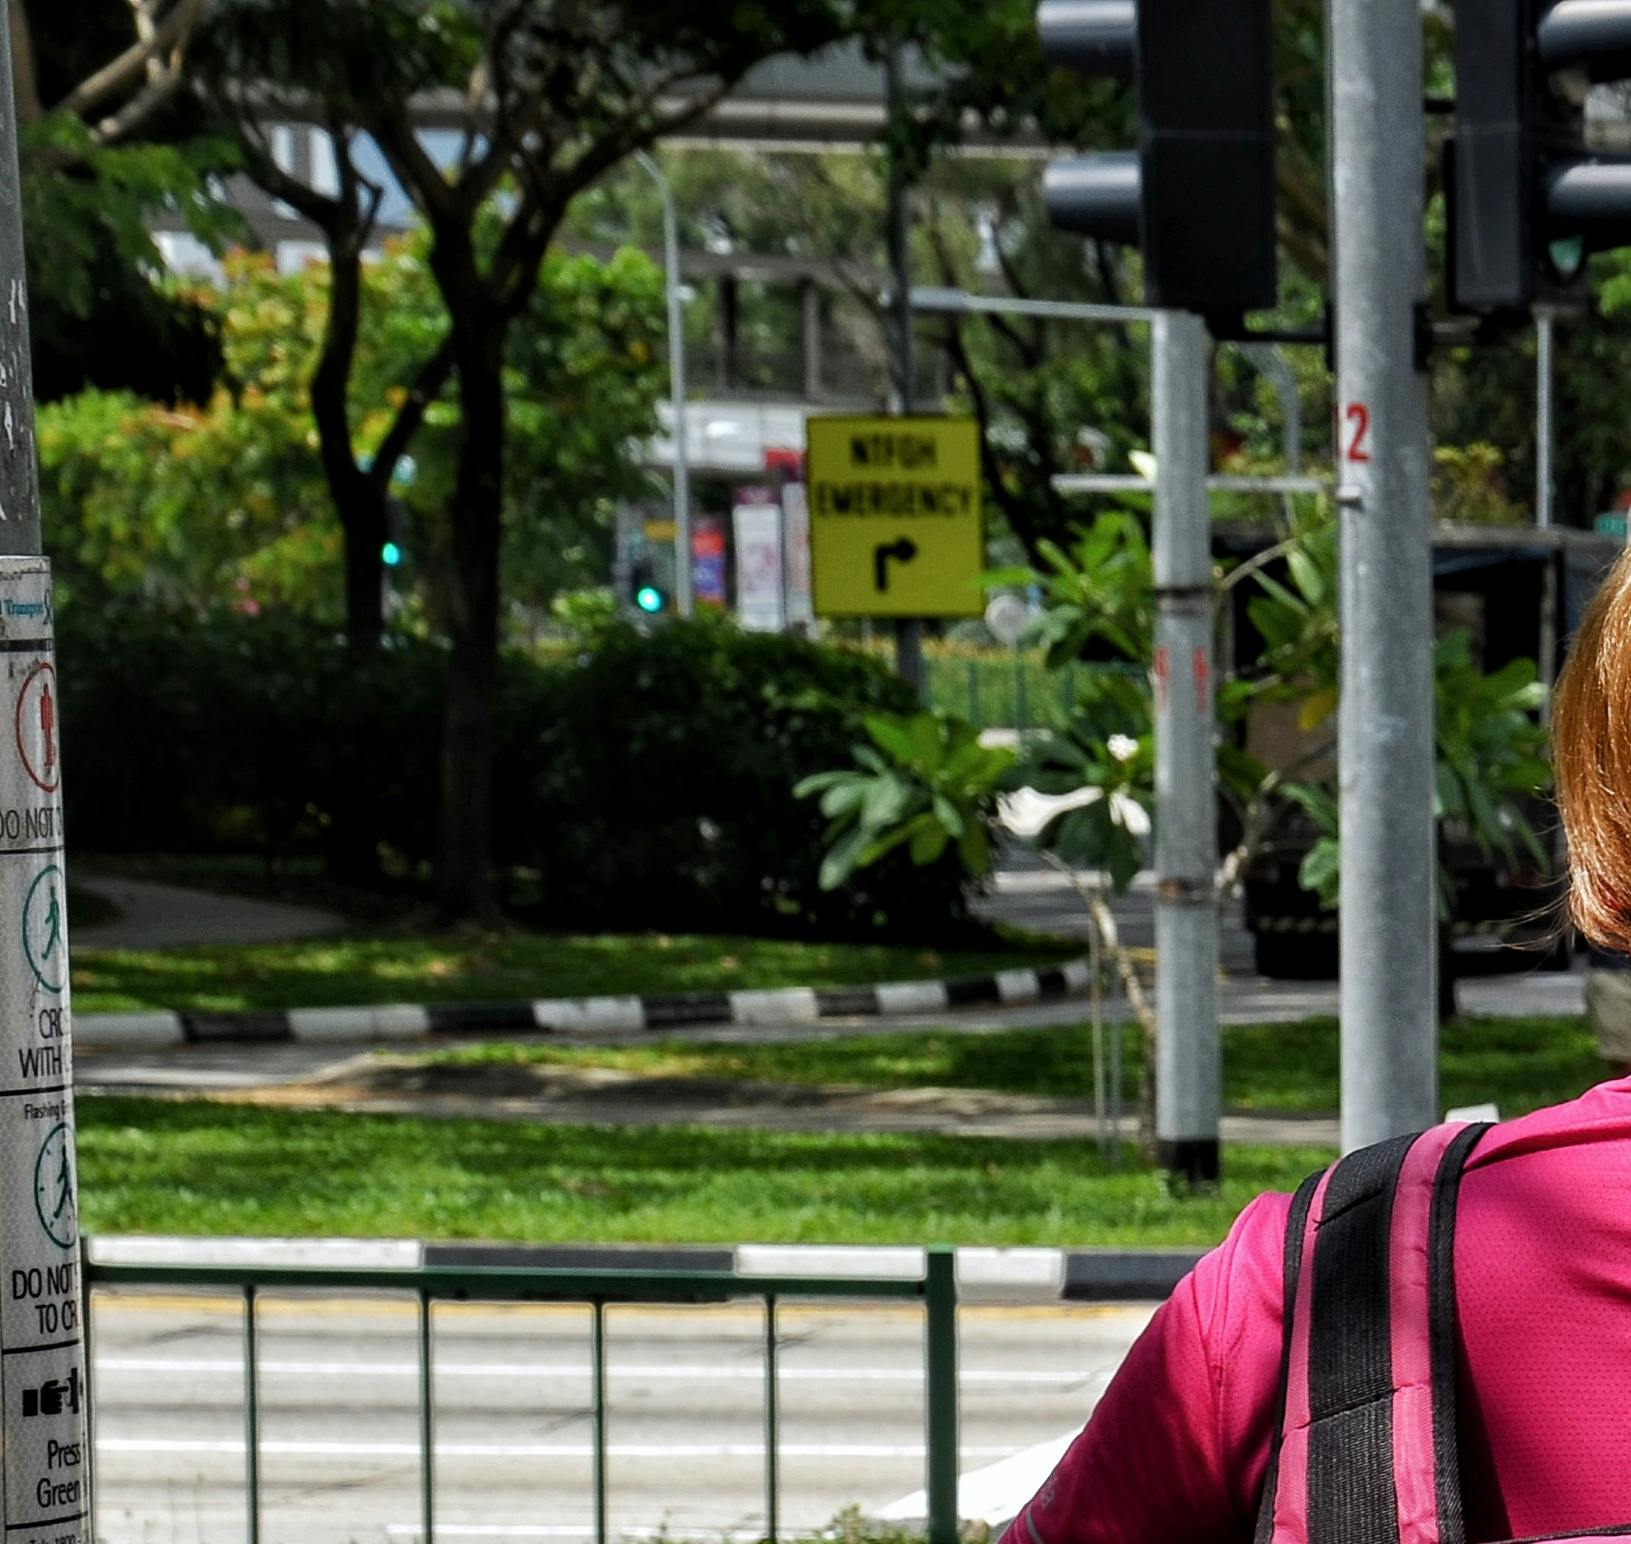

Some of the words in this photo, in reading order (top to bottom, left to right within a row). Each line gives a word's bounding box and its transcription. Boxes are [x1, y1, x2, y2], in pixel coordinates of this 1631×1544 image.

[815, 480, 972, 517] EMERGENCY
[25, 807, 54, 839] NOT
[18, 1046, 62, 1078] WITH
[12, 1268, 42, 1300] DO
[47, 1263, 73, 1296] NOT
[35, 1303, 58, 1334] TO
[48, 1439, 81, 1470] Press
[36, 1478, 81, 1508] Green
